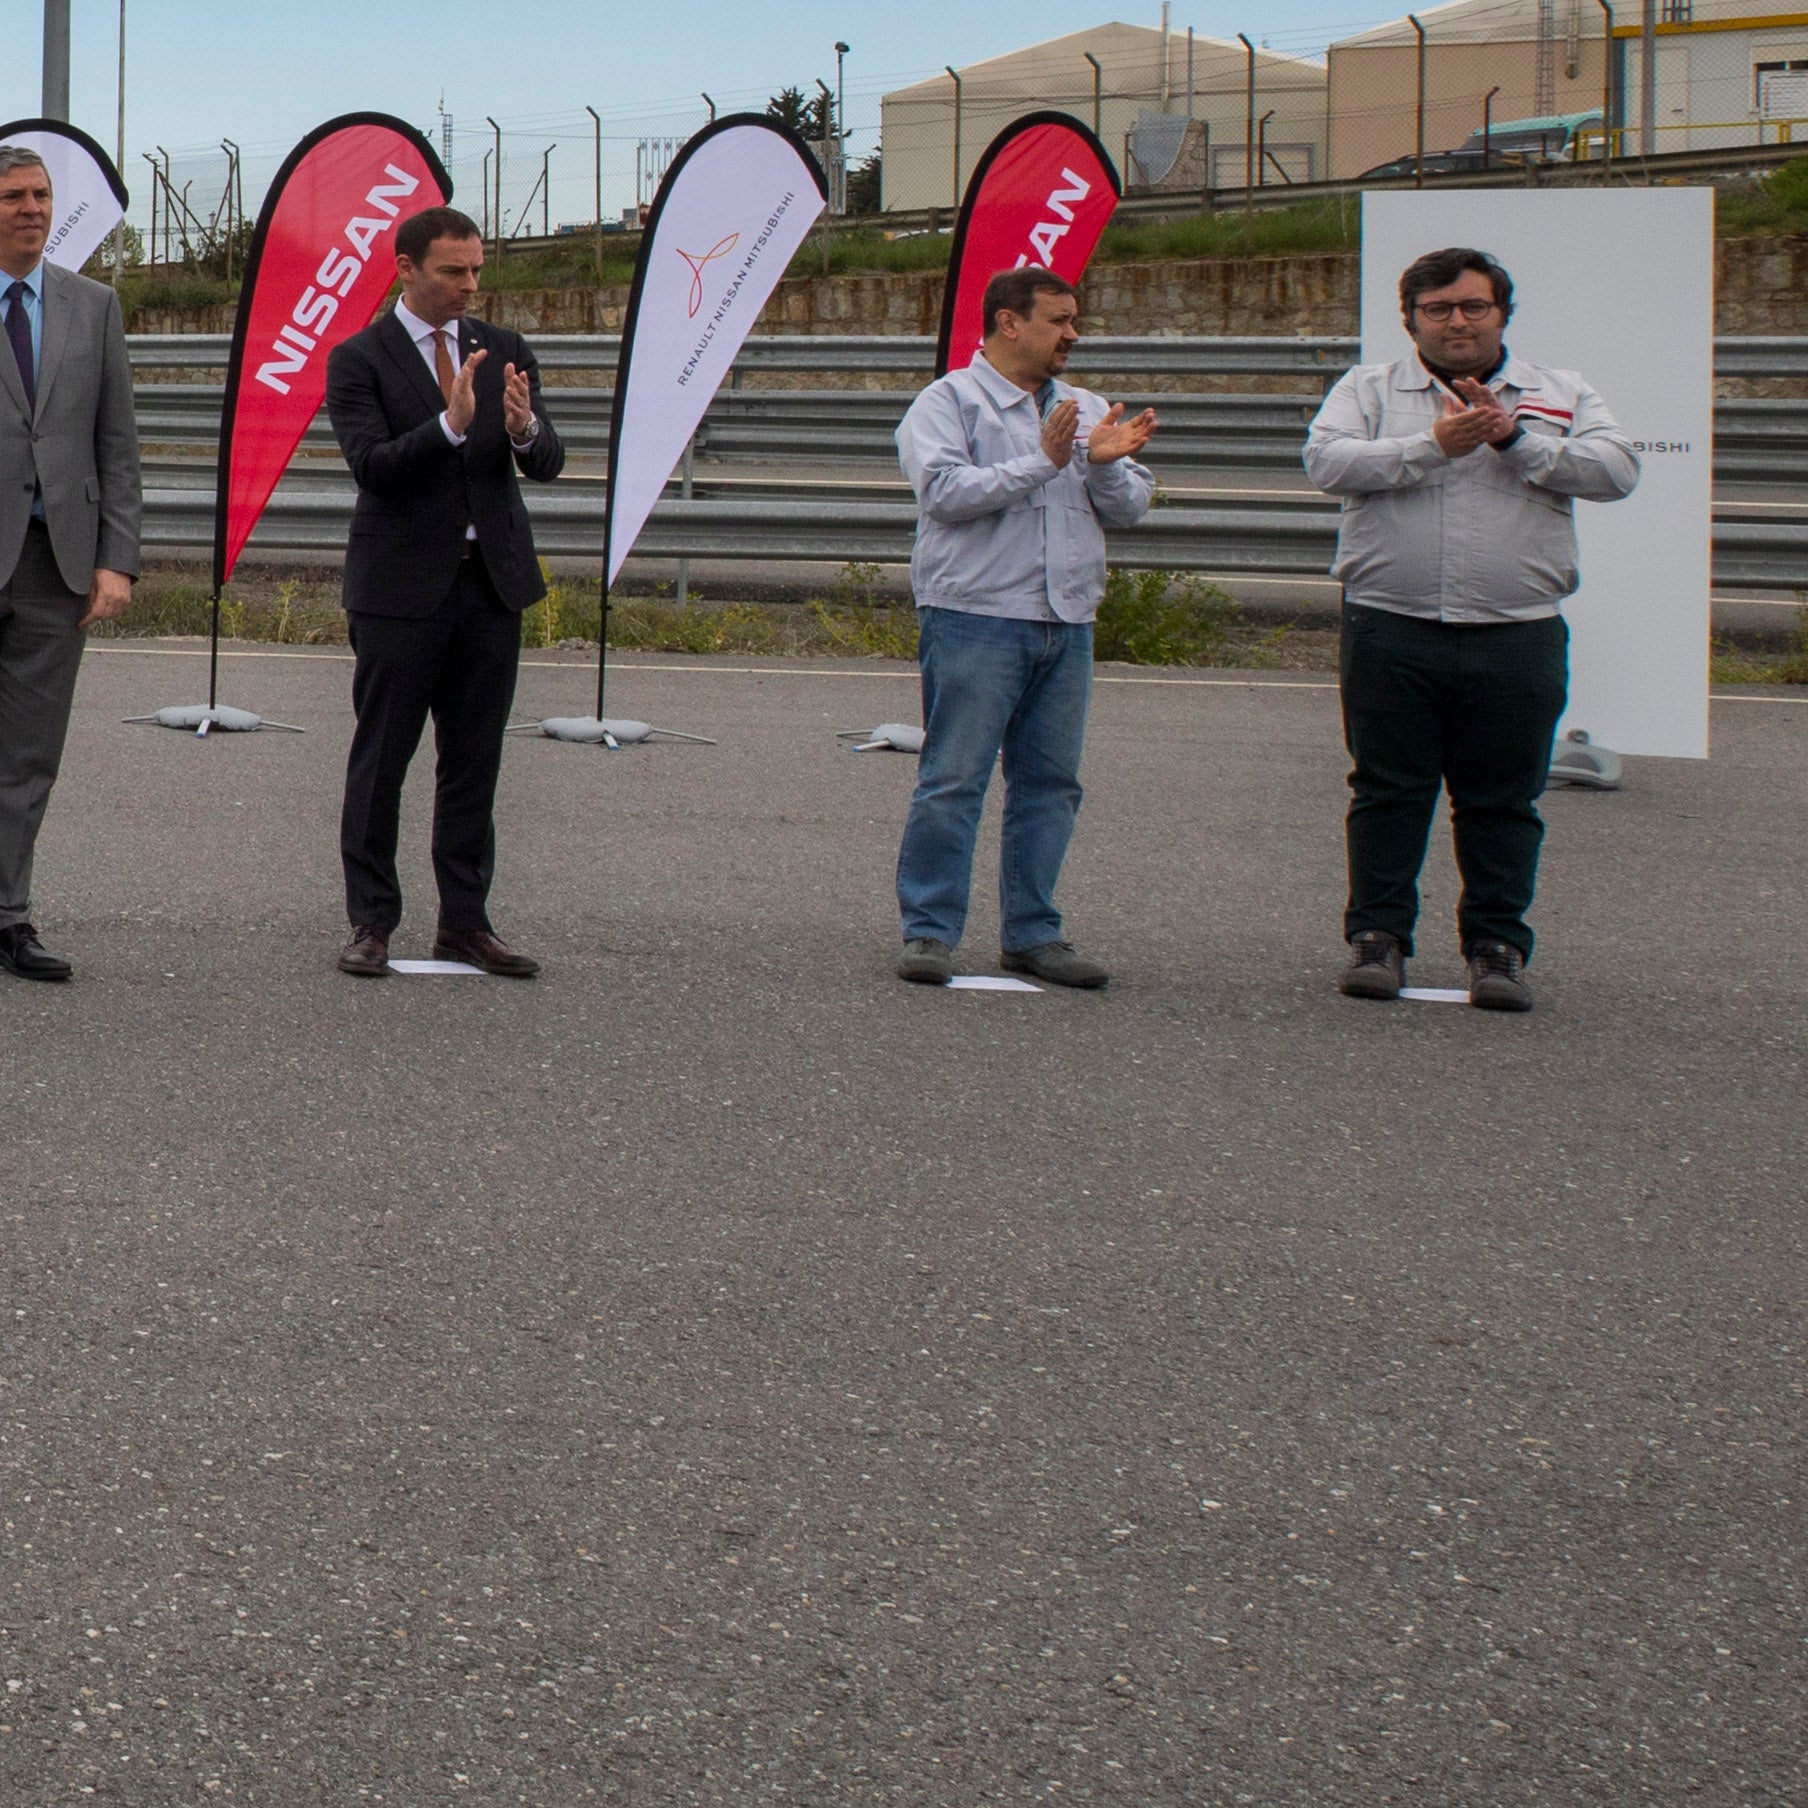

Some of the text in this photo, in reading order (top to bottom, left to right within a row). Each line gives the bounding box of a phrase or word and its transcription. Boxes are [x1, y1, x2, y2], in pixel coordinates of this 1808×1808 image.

[44, 201, 90, 255] SUBISHI
[254, 163, 421, 396] NISSAN
[677, 191, 795, 387] RENAULT NISSAN MITSUBISHI
[1633, 441, 1691, 453] BISHI
